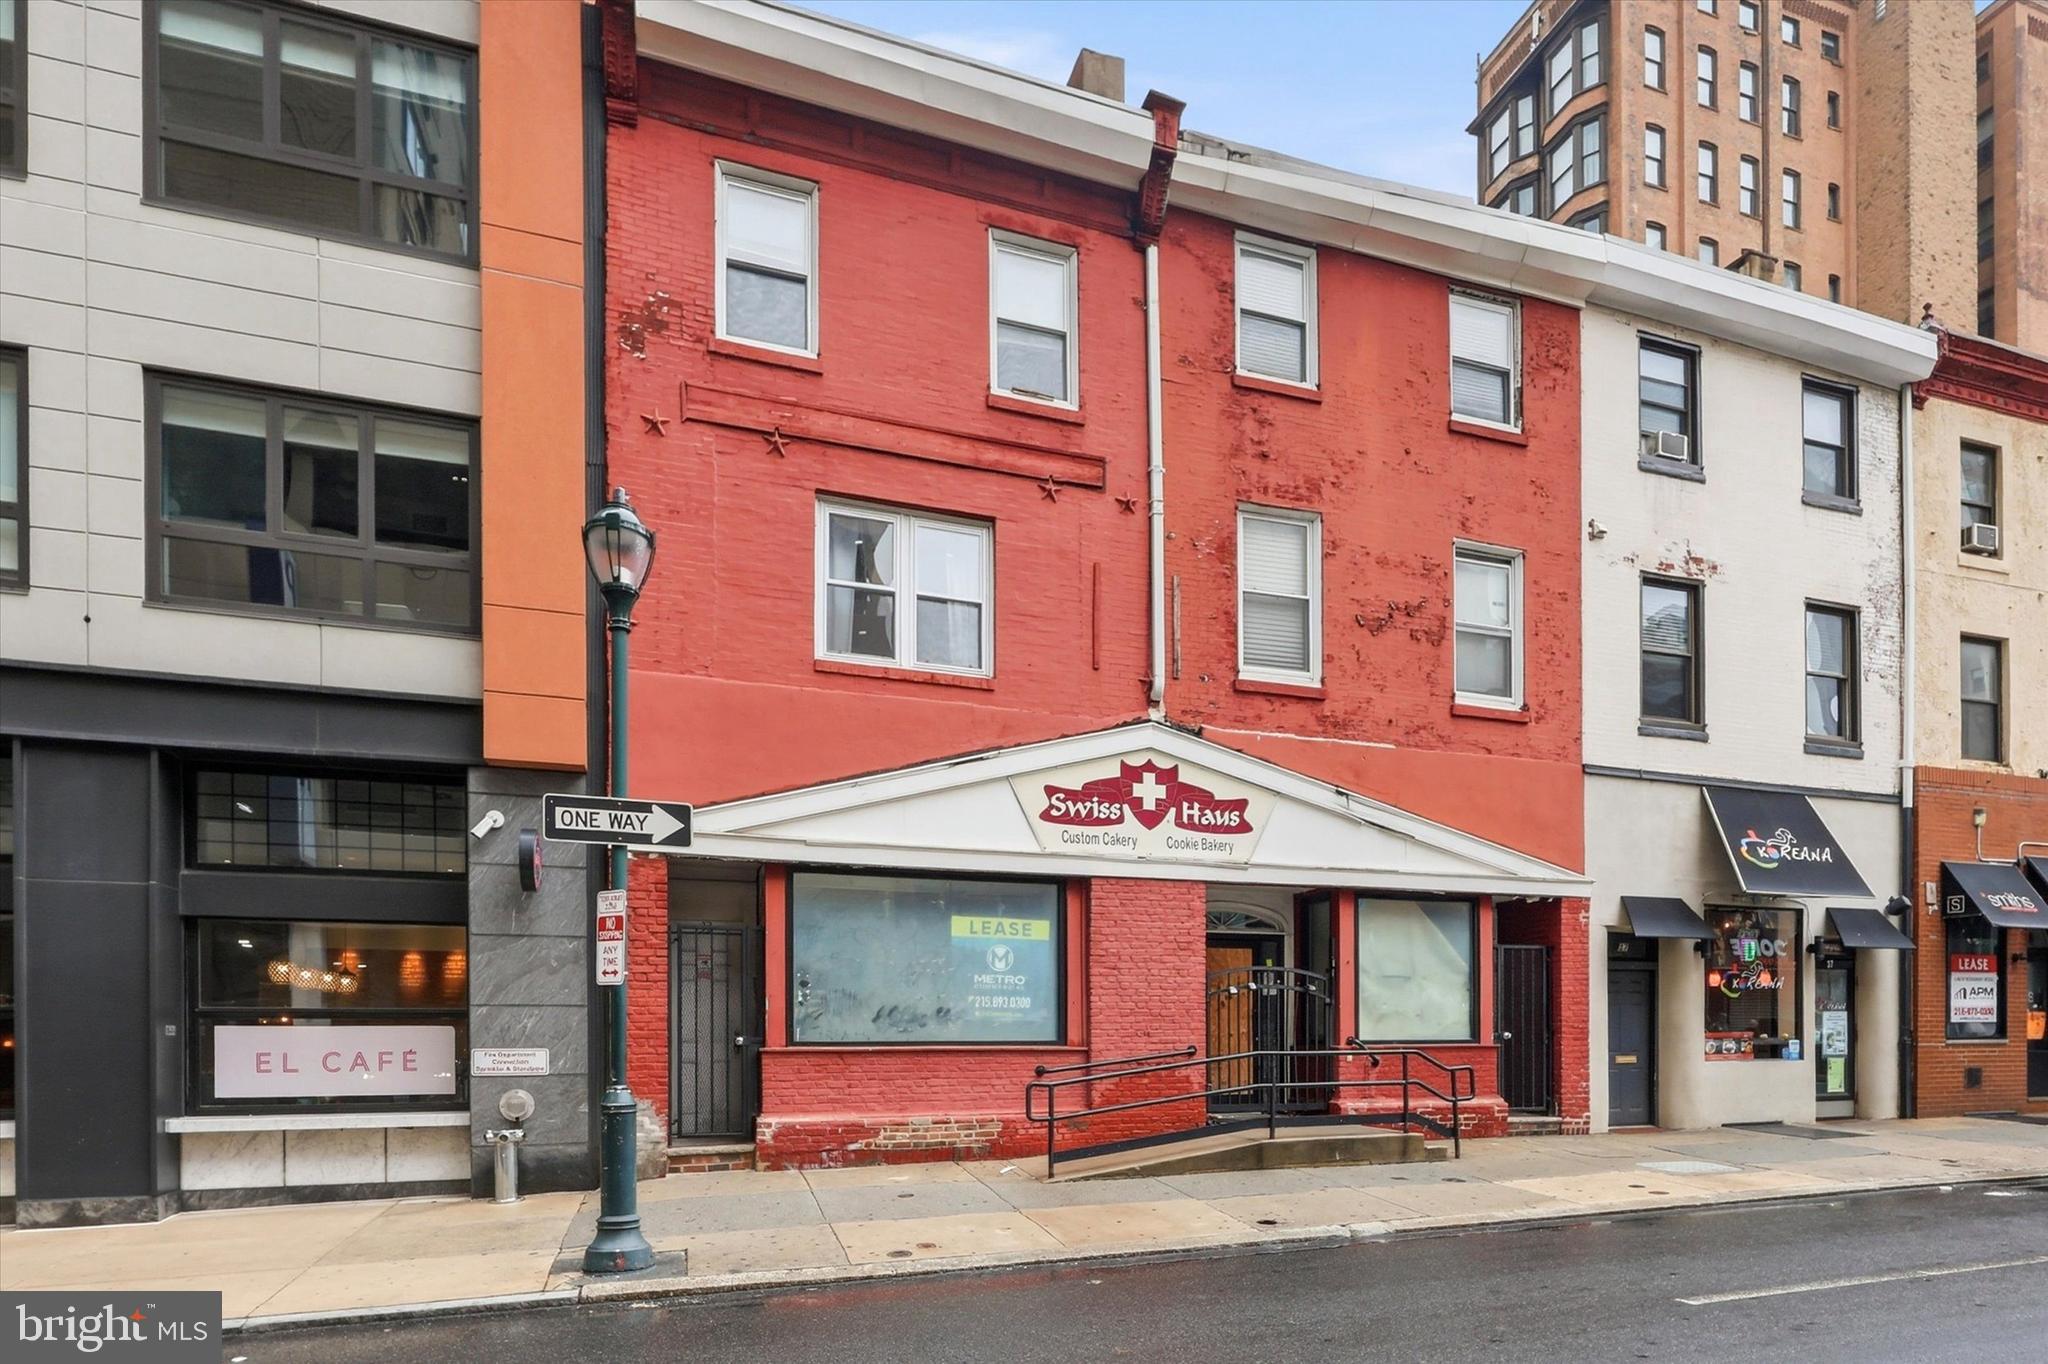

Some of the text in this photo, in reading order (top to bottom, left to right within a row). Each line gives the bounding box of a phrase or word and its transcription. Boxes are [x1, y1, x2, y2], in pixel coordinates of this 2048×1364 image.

[1049, 793, 1241, 827] Swiss Haus
[561, 810, 649, 832] ONE WAY
[1061, 830, 1138, 850] Custom Cakery
[1166, 837, 1234, 855] Cookie Bakery
[1756, 845, 1833, 863] KOREANA
[1950, 898, 1961, 911] S
[1988, 892, 2035, 908] smiths
[605, 916, 616, 930] NO
[969, 920, 1032, 937] LEASE
[603, 945, 618, 955] ANY
[602, 957, 619, 967] TIME
[1958, 957, 1989, 971] LEASE
[974, 974, 1025, 985] METRO
[1969, 987, 1994, 996] APM
[255, 1048, 418, 1073] EL CAFÉ
